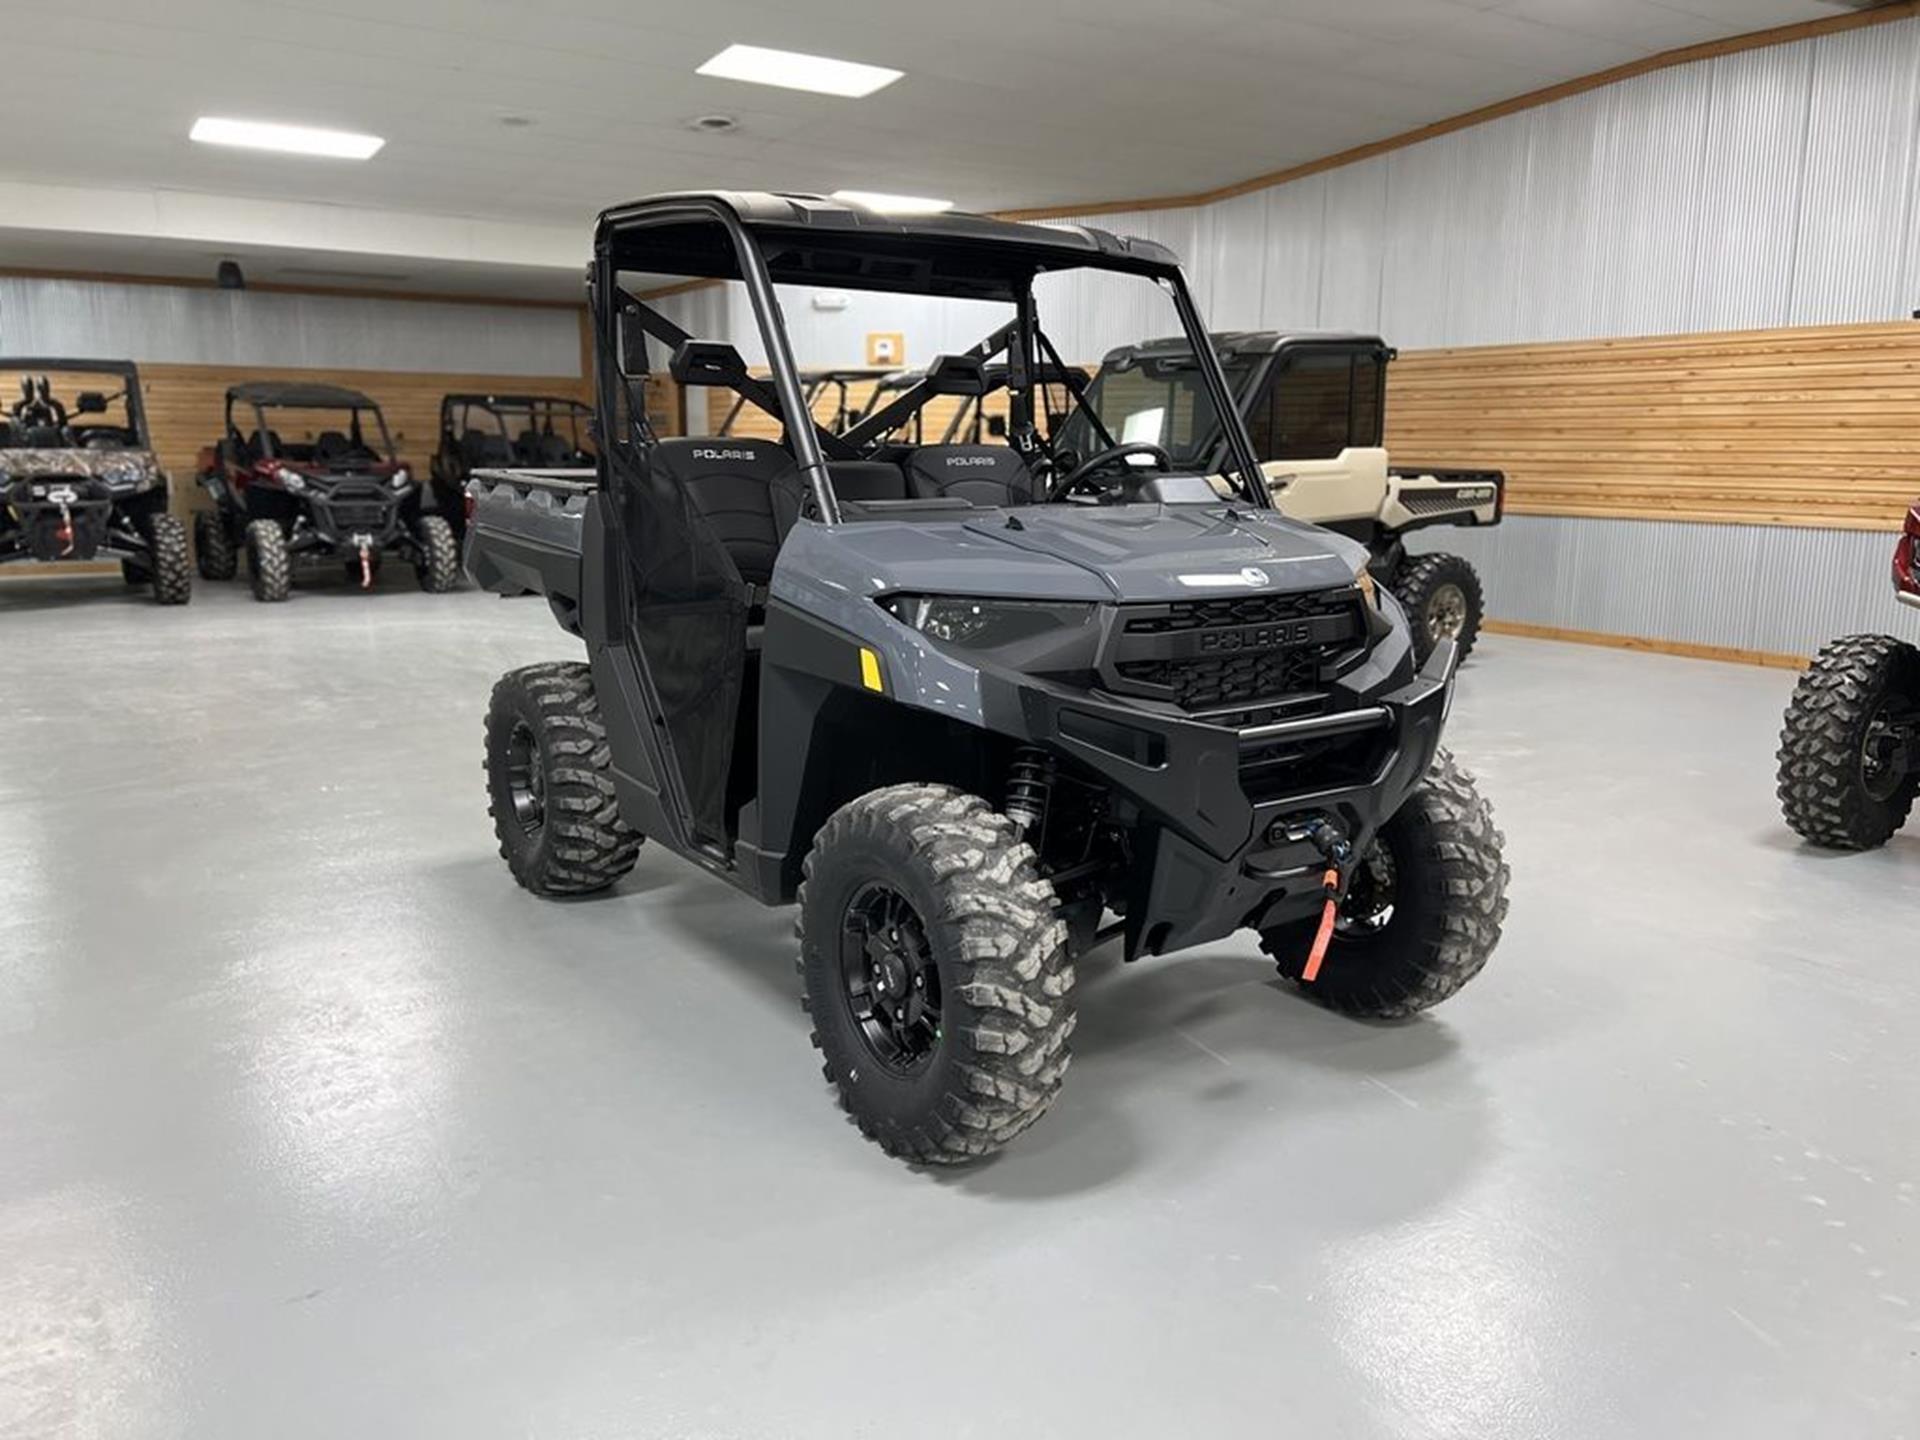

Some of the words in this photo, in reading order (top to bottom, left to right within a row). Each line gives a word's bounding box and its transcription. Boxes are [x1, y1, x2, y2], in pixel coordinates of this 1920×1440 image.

[692, 449, 756, 461] POLARIS
[945, 456, 996, 467] POLARIS
[1201, 625, 1310, 653] POLARIS
